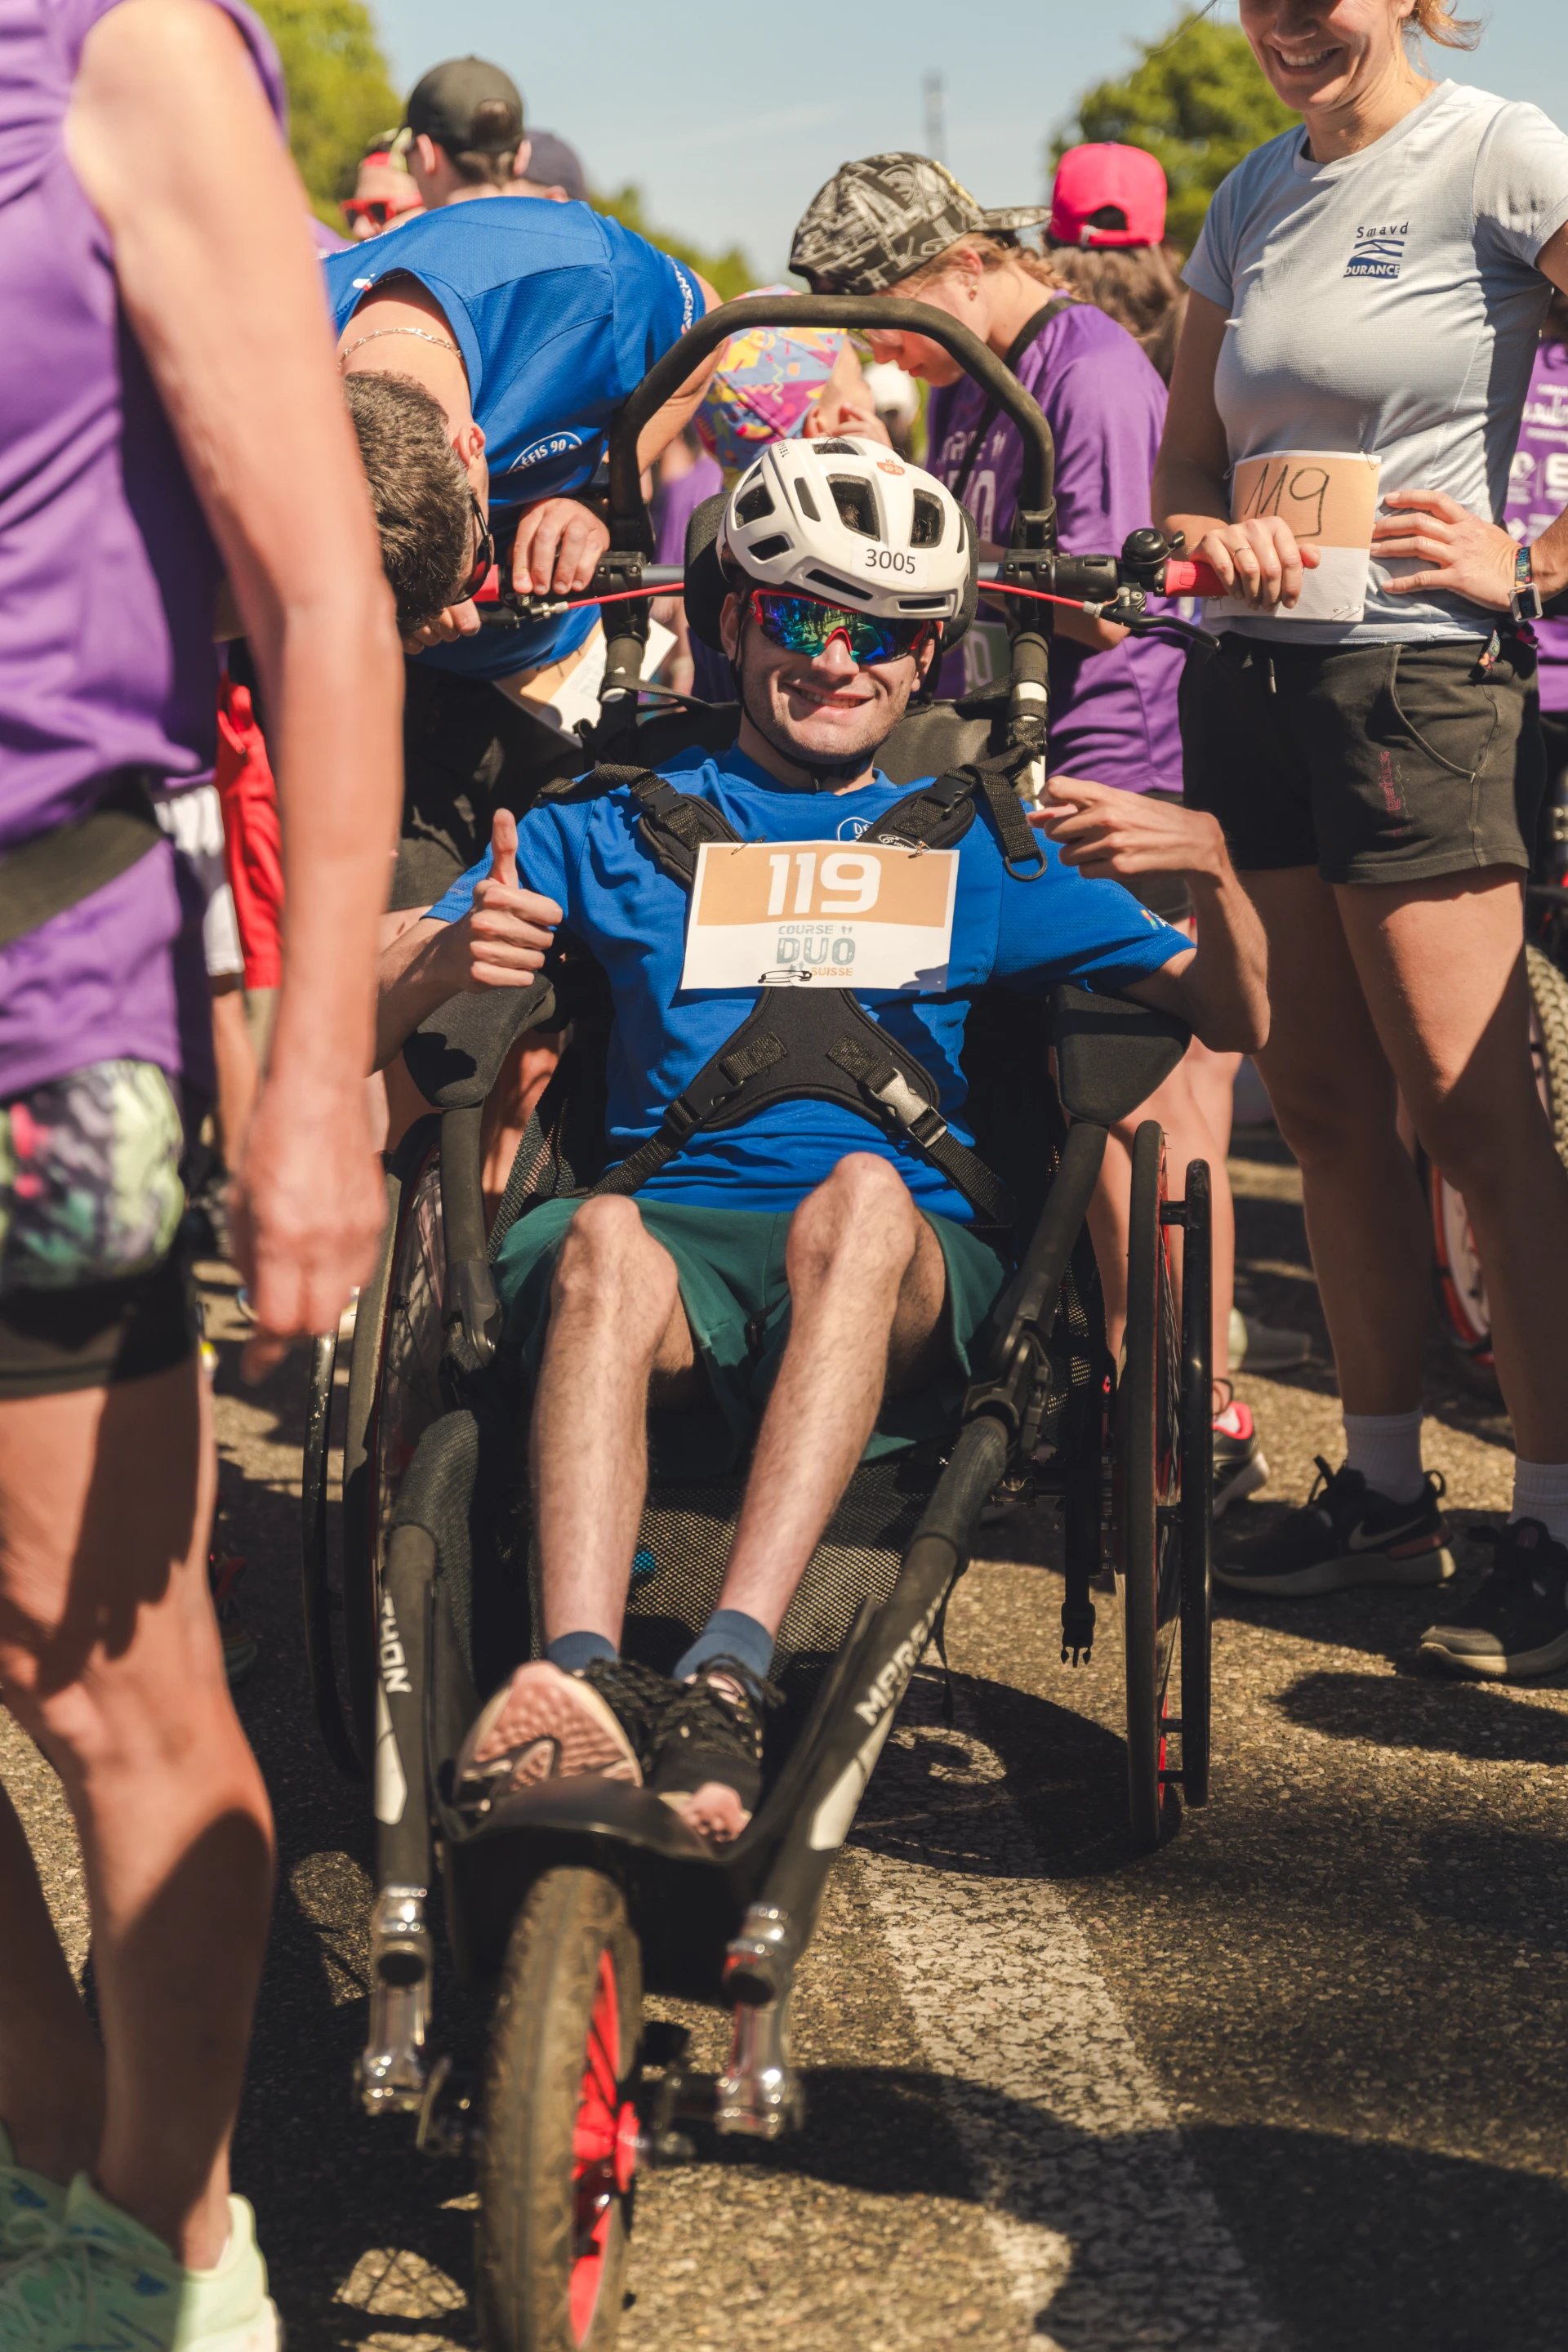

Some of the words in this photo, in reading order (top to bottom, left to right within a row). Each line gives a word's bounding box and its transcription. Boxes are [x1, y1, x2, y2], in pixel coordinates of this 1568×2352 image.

[1356, 221, 1409, 238] Smavd
[1345, 265, 1401, 275] DURANCE
[550, 439, 567, 453] 90
[1244, 462, 1330, 538] 119
[865, 548, 915, 574] 3005
[767, 852, 882, 916] 119
[777, 924, 834, 935] COURSE
[776, 937, 856, 965] DUO
[811, 966, 853, 977] SUISSE
